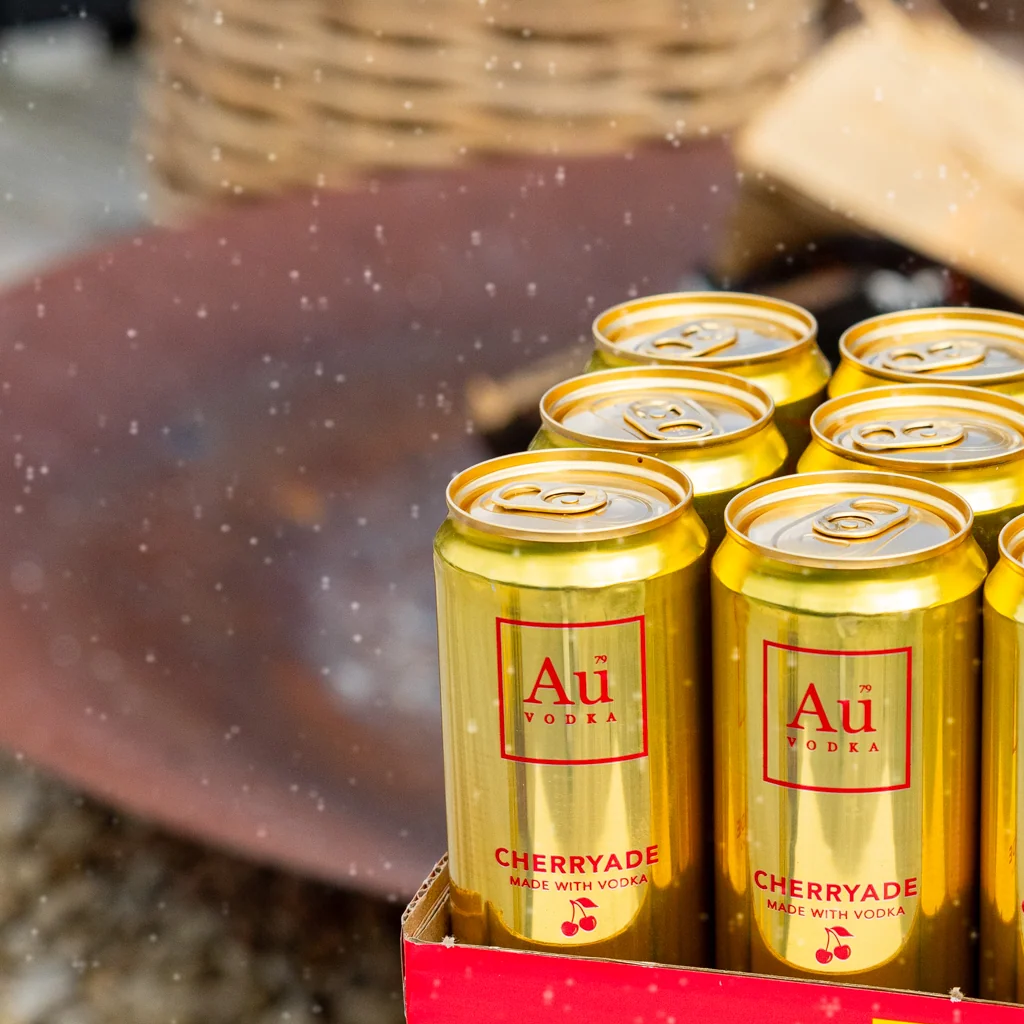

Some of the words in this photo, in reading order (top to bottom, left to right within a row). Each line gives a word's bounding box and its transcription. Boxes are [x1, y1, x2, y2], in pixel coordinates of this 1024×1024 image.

[594, 655, 608, 664] 79
[523, 656, 614, 707] Au
[858, 684, 872, 693] 79
[786, 682, 877, 735] Au
[523, 711, 618, 726] VODKA
[786, 737, 880, 752] VODKA
[494, 843, 660, 874] CHERRYADE
[509, 875, 550, 891] MADE
[554, 881, 594, 892] WITH
[597, 873, 649, 890] VODKA
[753, 869, 919, 902] CHERRYADE
[766, 900, 807, 918] MADE
[810, 908, 850, 920] WITH
[853, 904, 906, 920] VODKA
